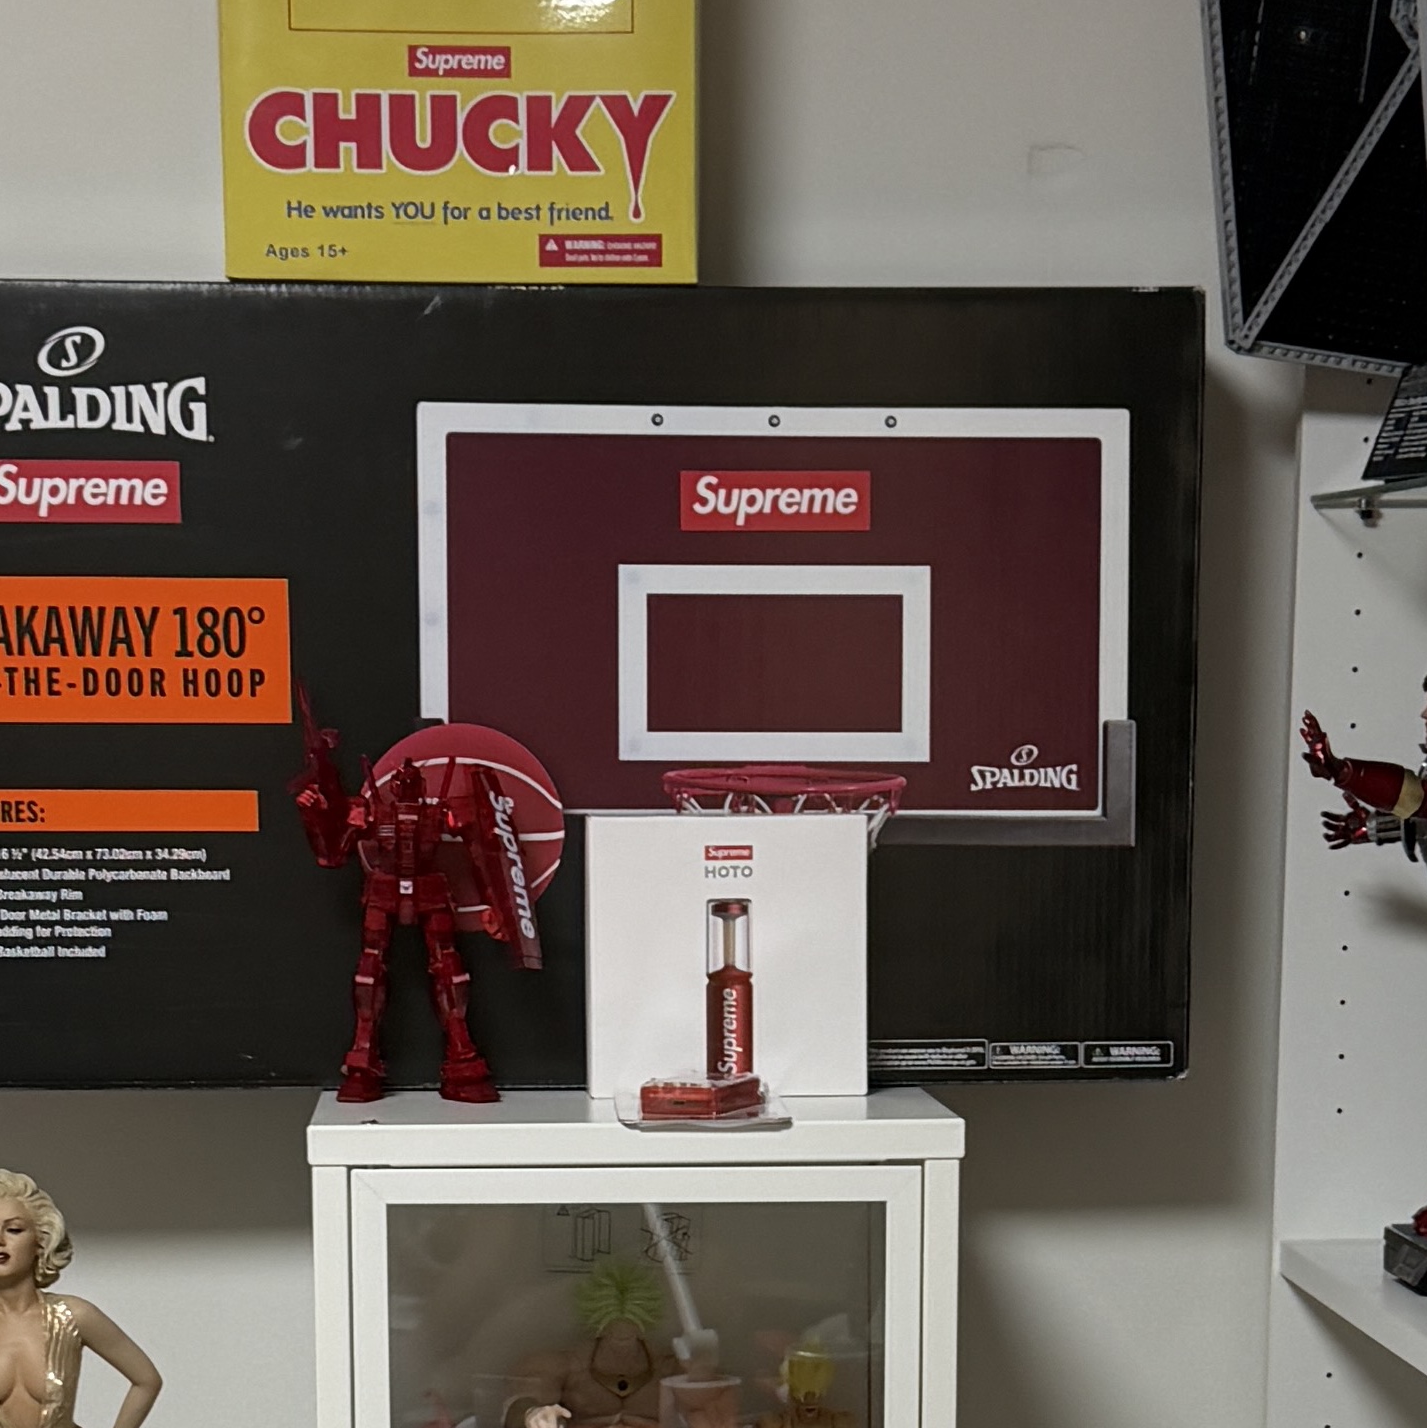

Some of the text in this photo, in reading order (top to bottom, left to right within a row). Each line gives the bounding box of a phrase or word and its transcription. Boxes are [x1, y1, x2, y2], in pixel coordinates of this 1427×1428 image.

[414, 47, 506, 75] Supreme
[245, 87, 677, 224] CHUCKY
[287, 201, 613, 226] He wants YOU for a best friend.
[266, 243, 348, 260] Ages 15+
[692, 475, 859, 525] Supreme
[173, 606, 266, 659] 180°
[182, 668, 266, 698] HOOP
[970, 764, 1080, 791] SPALDING
[489, 789, 537, 940] Supreme
[707, 846, 751, 859] Supreme
[42, 868, 85, 880] Durable
[88, 868, 167, 883] Polycarbonate
[170, 868, 230, 880] Backboard
[704, 865, 753, 879] HOTO
[60, 889, 83, 900] Rim
[0, 909, 26, 920] Door
[29, 909, 60, 920] Metal
[63, 909, 107, 920] Bracket
[109, 909, 134, 920] with
[136, 909, 168, 920] Foam
[36, 925, 52, 937] for
[54, 925, 112, 937] Protection
[57, 945, 106, 957] Included
[717, 988, 744, 1076] Supreme
